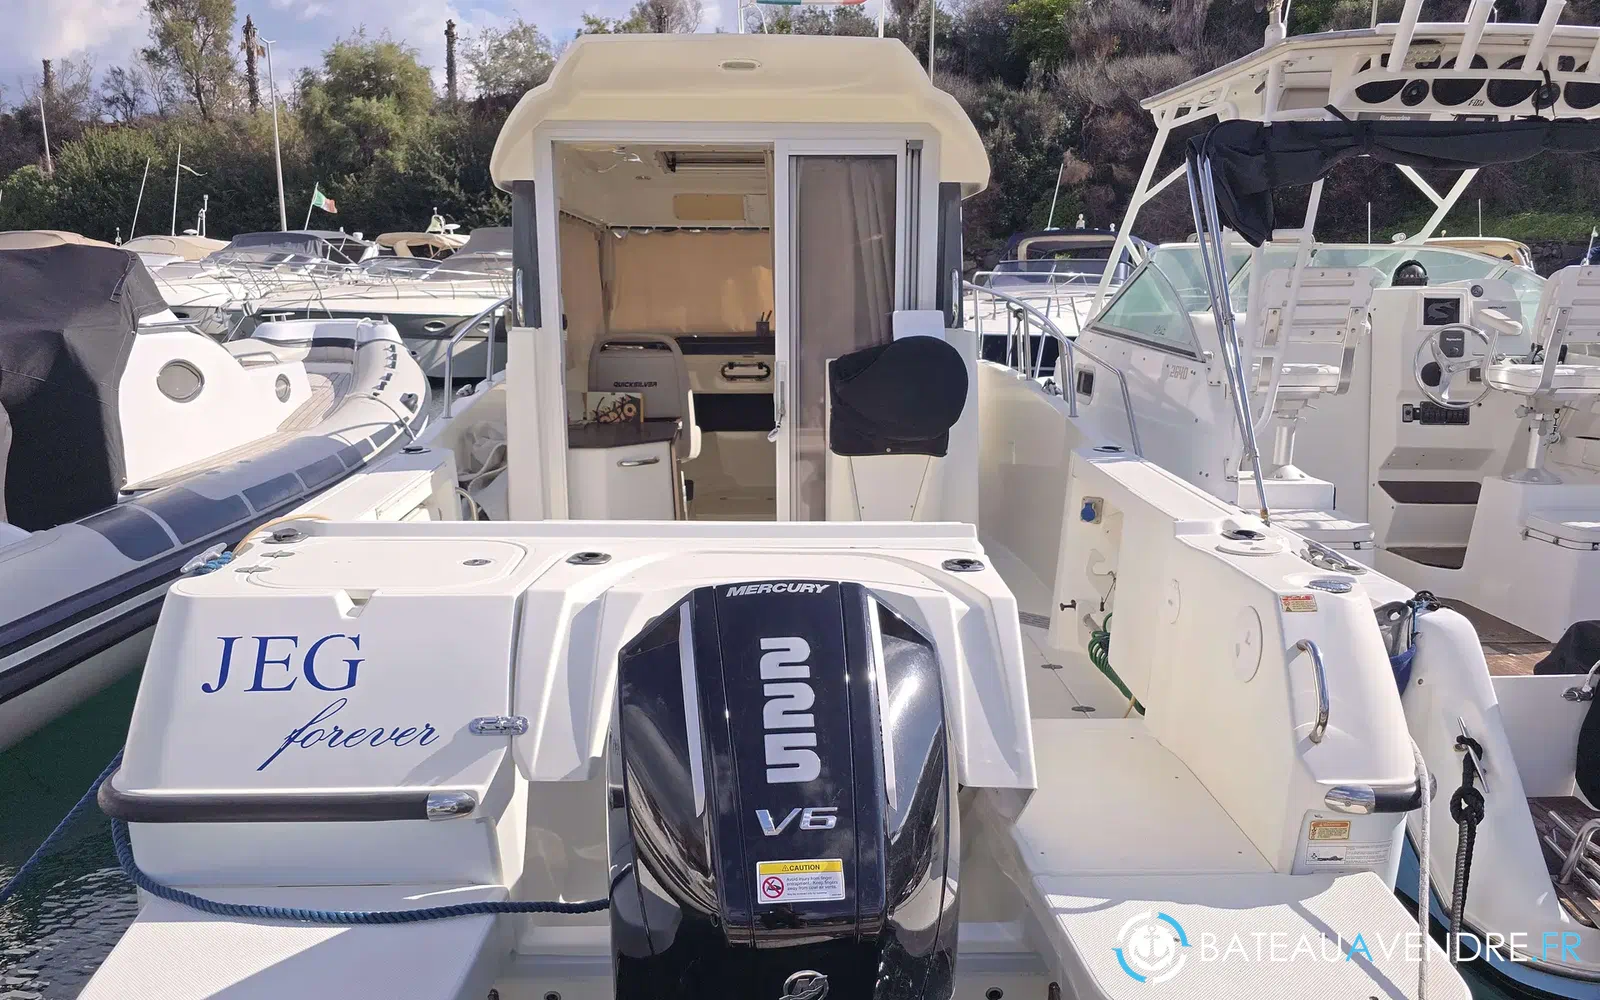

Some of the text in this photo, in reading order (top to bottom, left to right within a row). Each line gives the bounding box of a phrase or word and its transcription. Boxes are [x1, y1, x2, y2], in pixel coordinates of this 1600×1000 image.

[726, 583, 831, 598] MERCURY
[201, 633, 366, 694] JEG
[256, 697, 440, 772] forever
[759, 636, 822, 784] 225
[755, 806, 838, 836] V6
